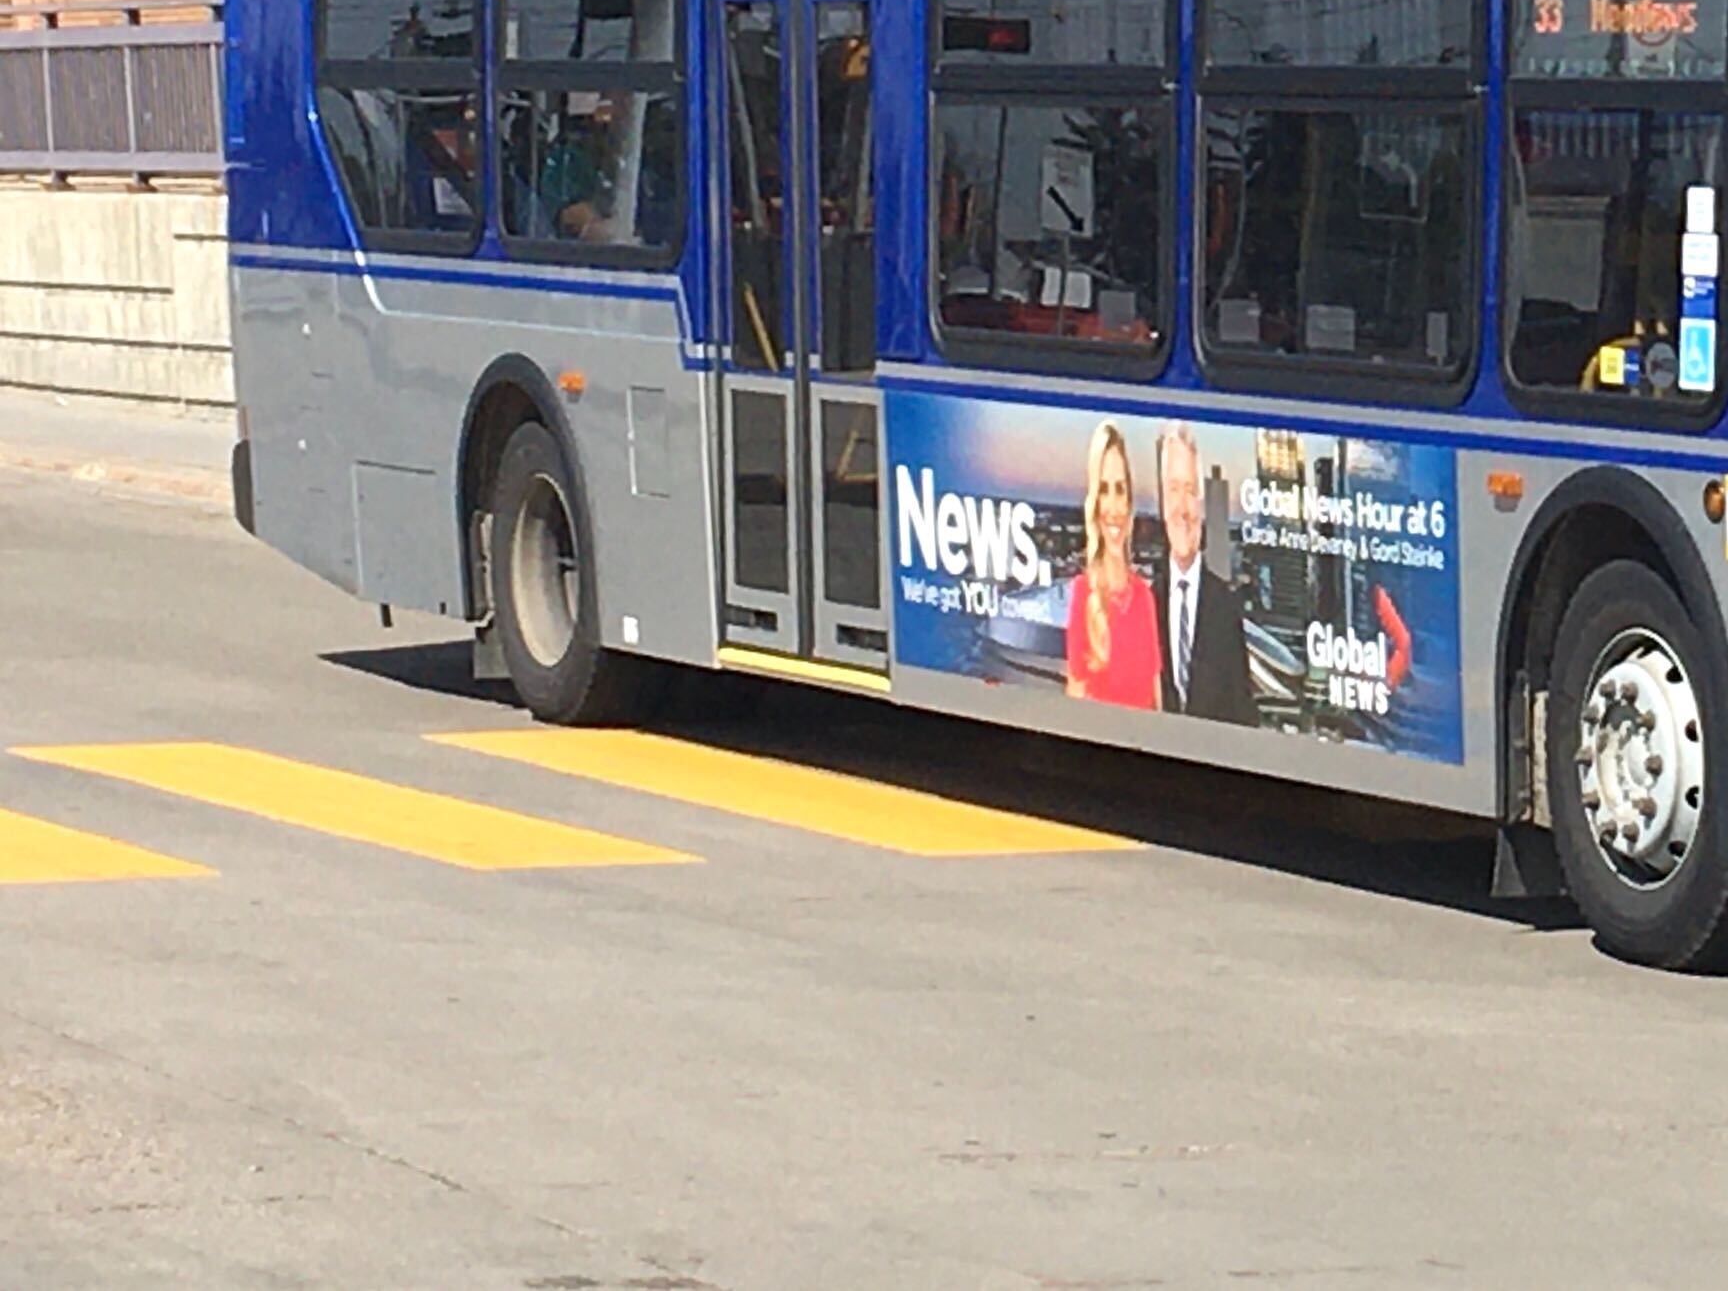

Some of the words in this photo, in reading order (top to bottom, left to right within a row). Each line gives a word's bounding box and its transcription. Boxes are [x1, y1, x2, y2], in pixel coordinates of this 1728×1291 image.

[896, 464, 1052, 587] News.
[1240, 477, 1300, 520] Global
[1303, 486, 1354, 528] News
[1356, 491, 1405, 533] Hour
[1407, 500, 1428, 535] at
[1430, 500, 1446, 539] 6
[960, 579, 1000, 618] YOU
[1306, 620, 1387, 678] Global
[1329, 674, 1392, 715] NEWS
